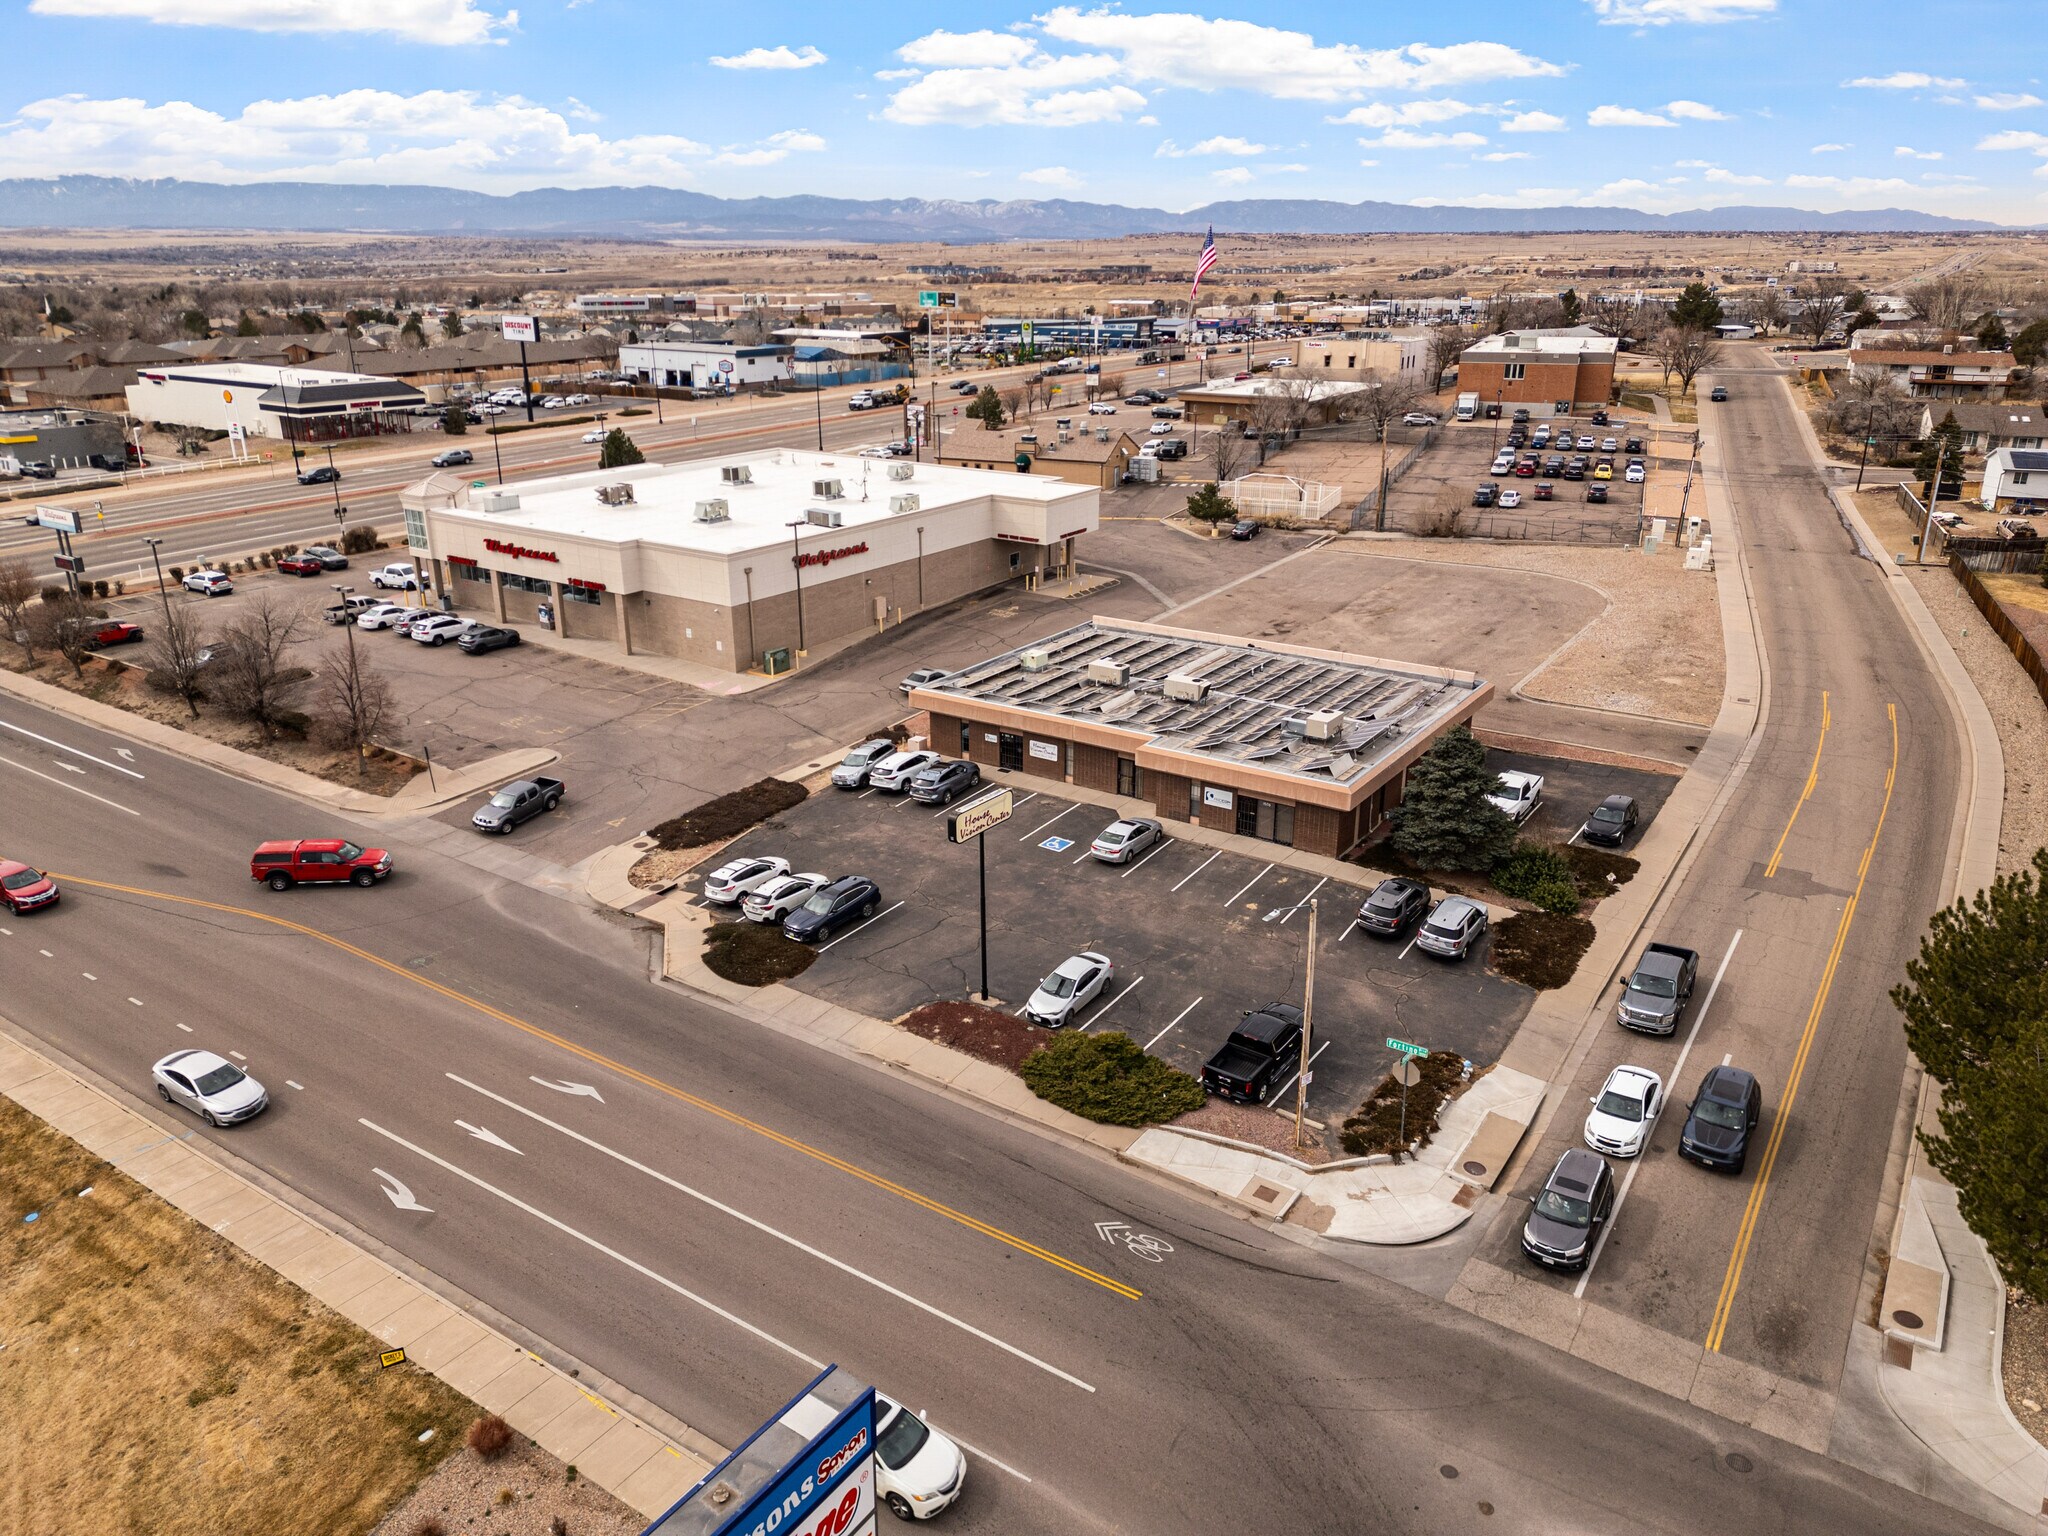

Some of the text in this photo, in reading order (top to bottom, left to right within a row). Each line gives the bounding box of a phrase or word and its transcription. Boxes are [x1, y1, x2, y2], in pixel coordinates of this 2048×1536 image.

[504, 321, 532, 329] DISCOUNT
[483, 538, 560, 563] Walgreens
[791, 541, 869, 569] Walgreens
[960, 810, 1010, 839] Vision Center
[964, 810, 990, 827] House
[1388, 1039, 1418, 1054] Fortino
[745, 1475, 814, 1536] sons
